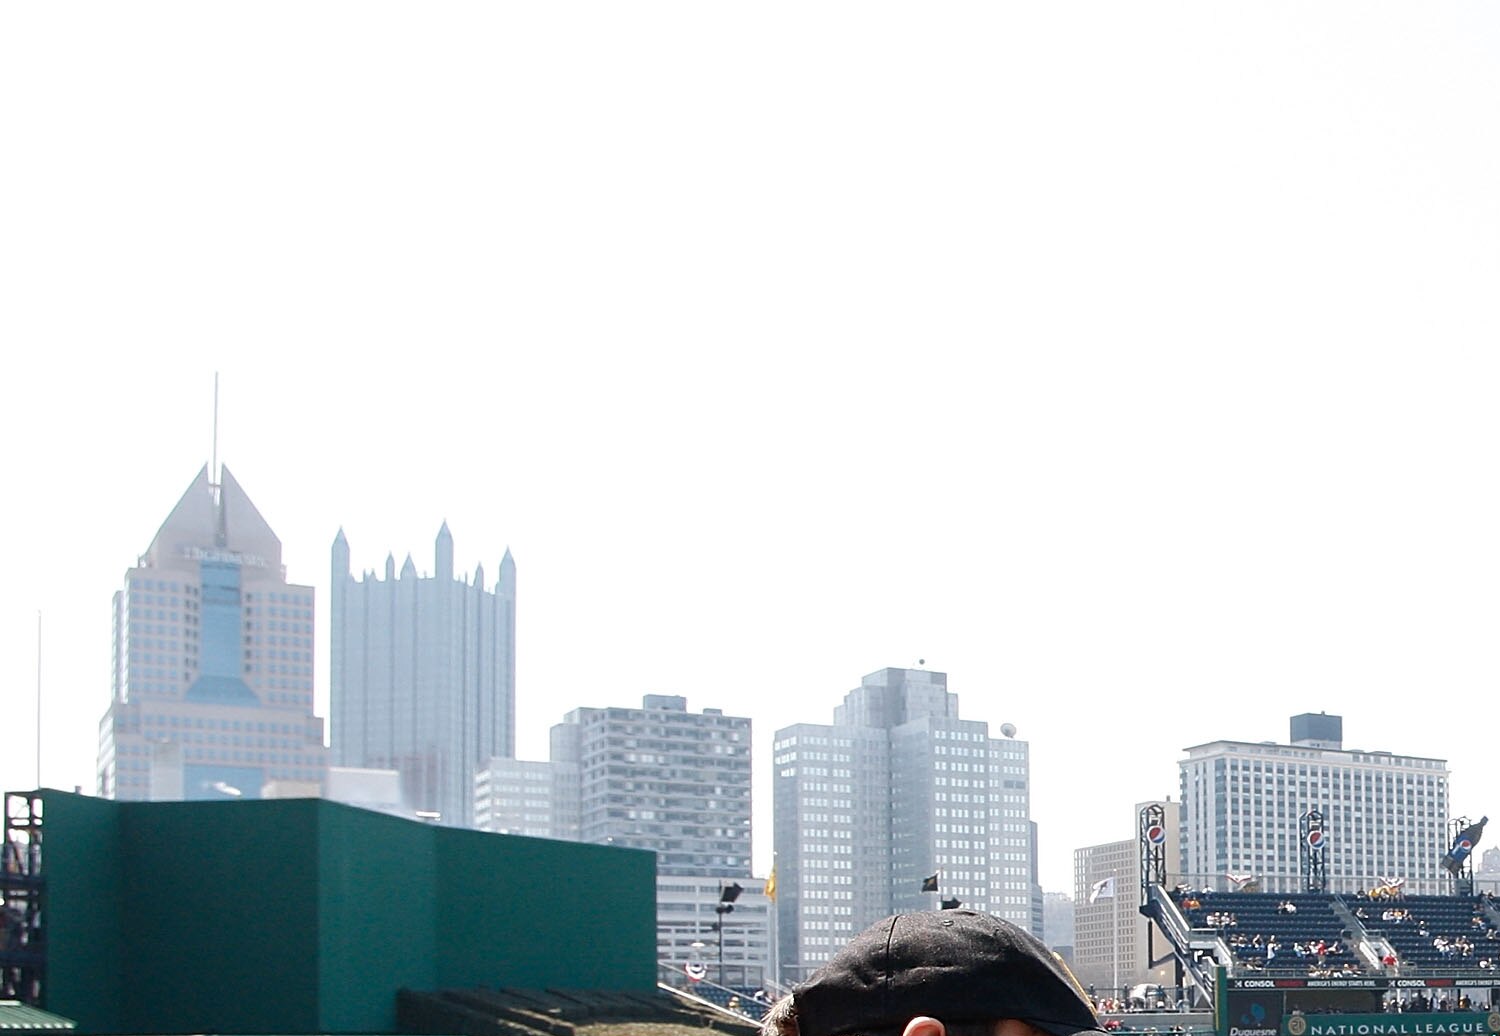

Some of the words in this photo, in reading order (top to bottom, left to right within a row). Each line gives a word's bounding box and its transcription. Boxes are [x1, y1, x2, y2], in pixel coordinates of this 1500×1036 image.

[1244, 980, 1275, 988] CONSOL
[1397, 979, 1426, 987] CONSOL
[1311, 1024, 1408, 1035] NATIONAL
[1415, 1023, 1484, 1033] LEAGUE
